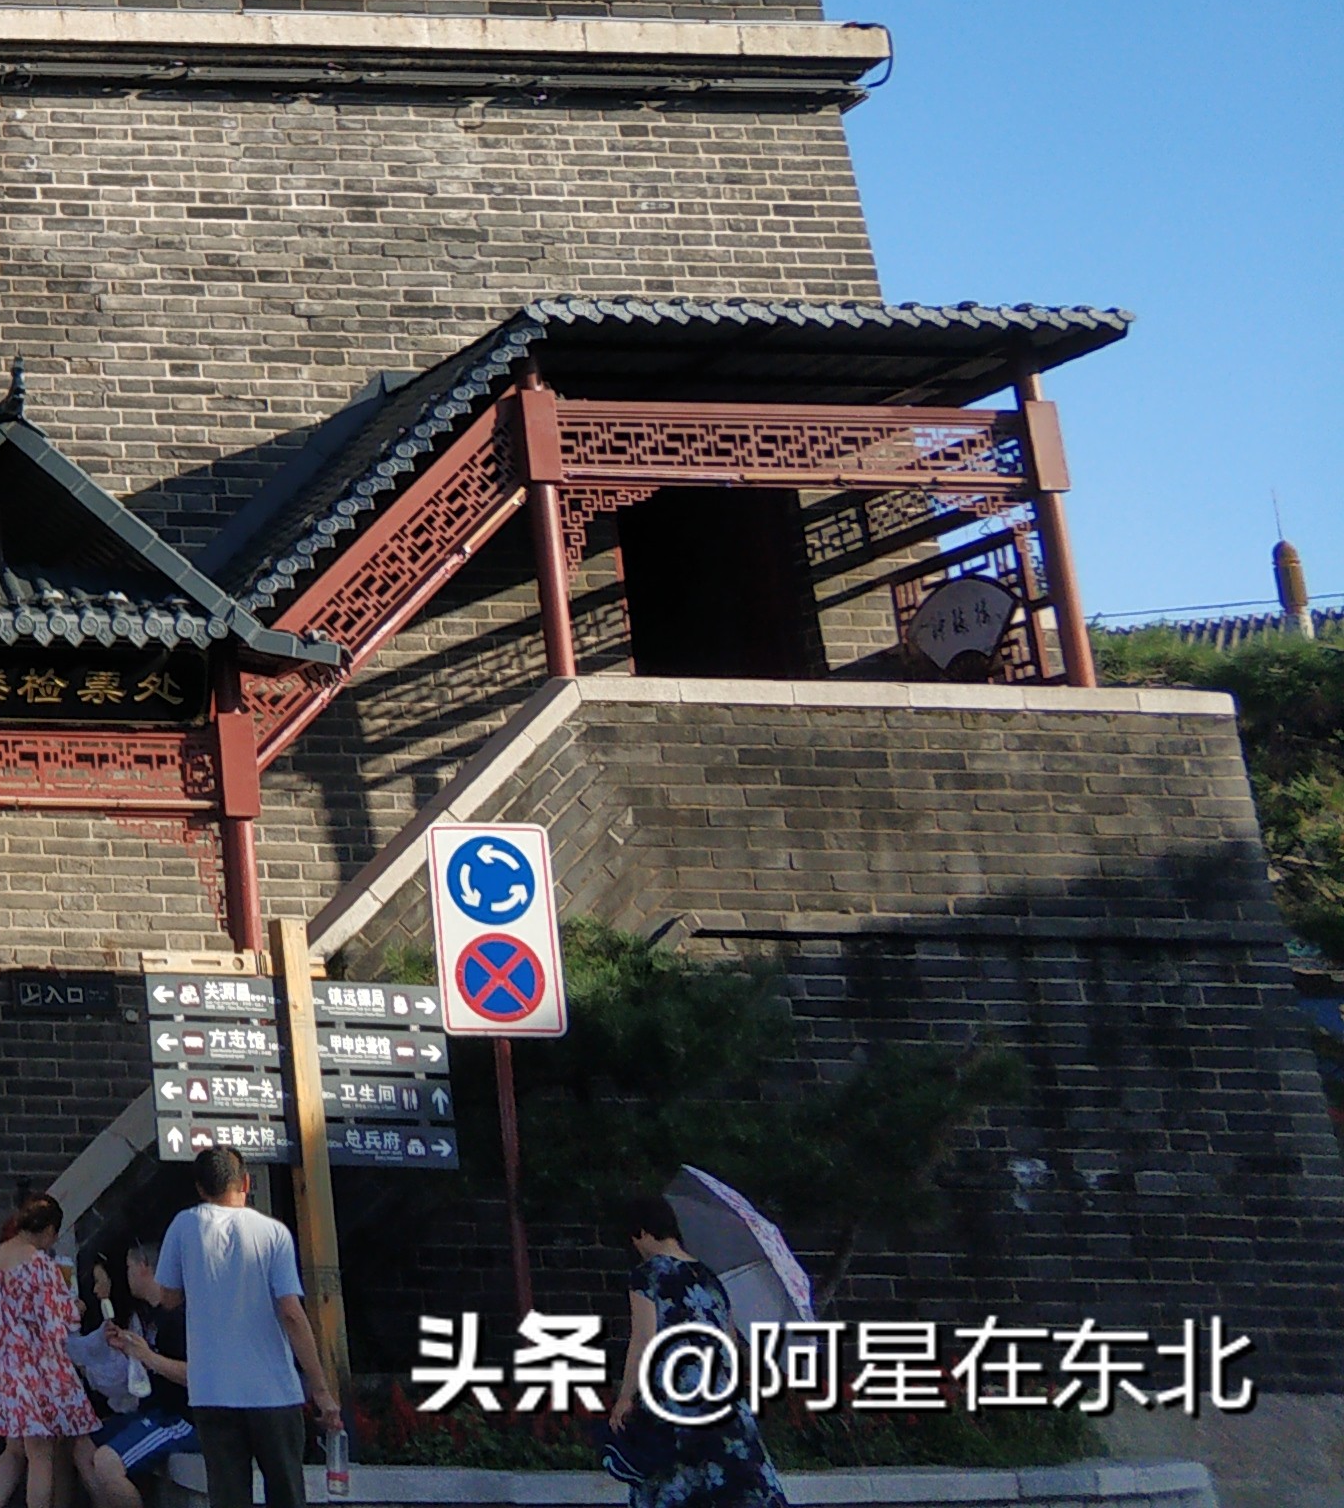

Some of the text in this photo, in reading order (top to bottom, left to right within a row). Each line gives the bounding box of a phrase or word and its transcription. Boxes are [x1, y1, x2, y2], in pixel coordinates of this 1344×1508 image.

[44, 985, 84, 1004] 入口
[209, 1028, 266, 1050] 方志馆
[212, 1077, 273, 1099] 天下第一关
[340, 1084, 397, 1104] 卫生间
[216, 1125, 275, 1147] 王家大院
[345, 1129, 402, 1151] 总兵府
